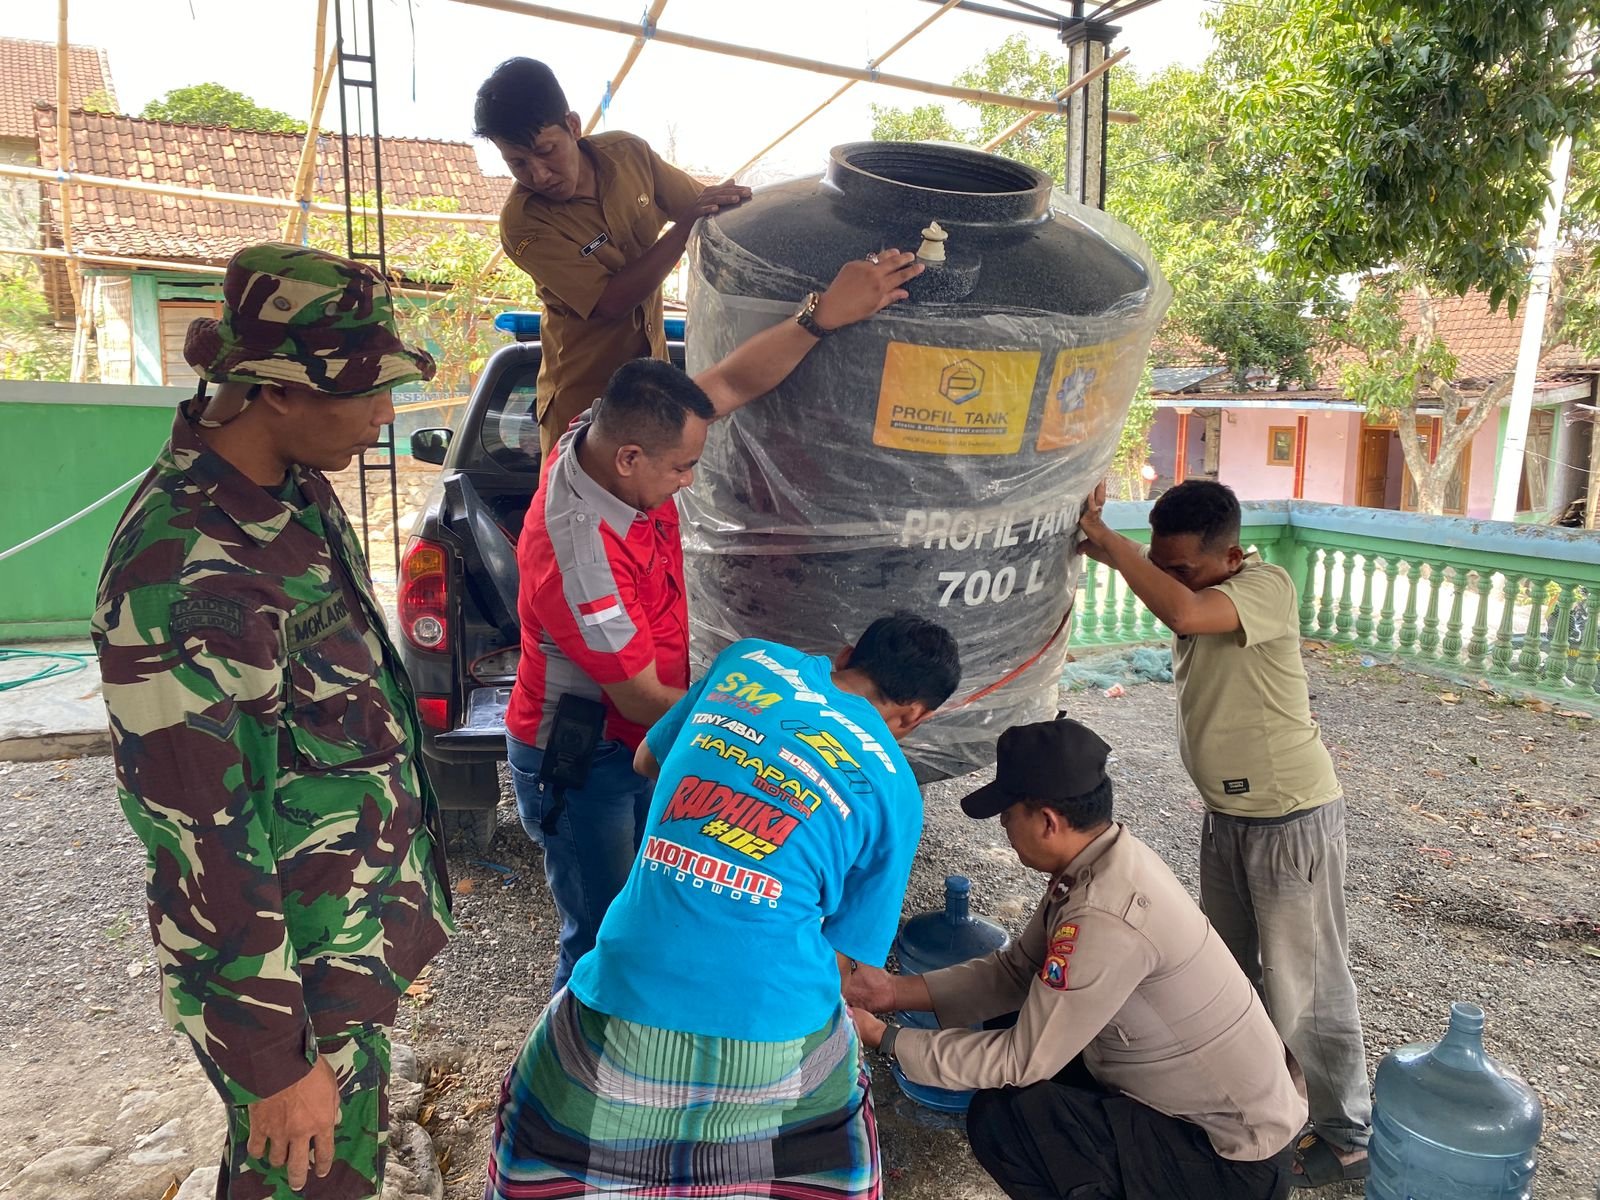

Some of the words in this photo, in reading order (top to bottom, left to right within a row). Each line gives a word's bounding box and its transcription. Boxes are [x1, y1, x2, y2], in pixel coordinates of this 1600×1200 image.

[892, 405, 957, 424] PROFIL
[965, 411, 1008, 425] TANK
[901, 508, 1019, 550] PROFIL
[938, 566, 1017, 607] 700
[1025, 559, 1044, 595] L
[176, 599, 239, 620] RAIDER
[716, 672, 783, 708] SM
[690, 733, 822, 813] HARAPAN
[660, 775, 801, 847] RADHIKA
[752, 775, 812, 820] MOTOR
[701, 818, 779, 861] #02
[643, 836, 783, 900] MOTOLITE
